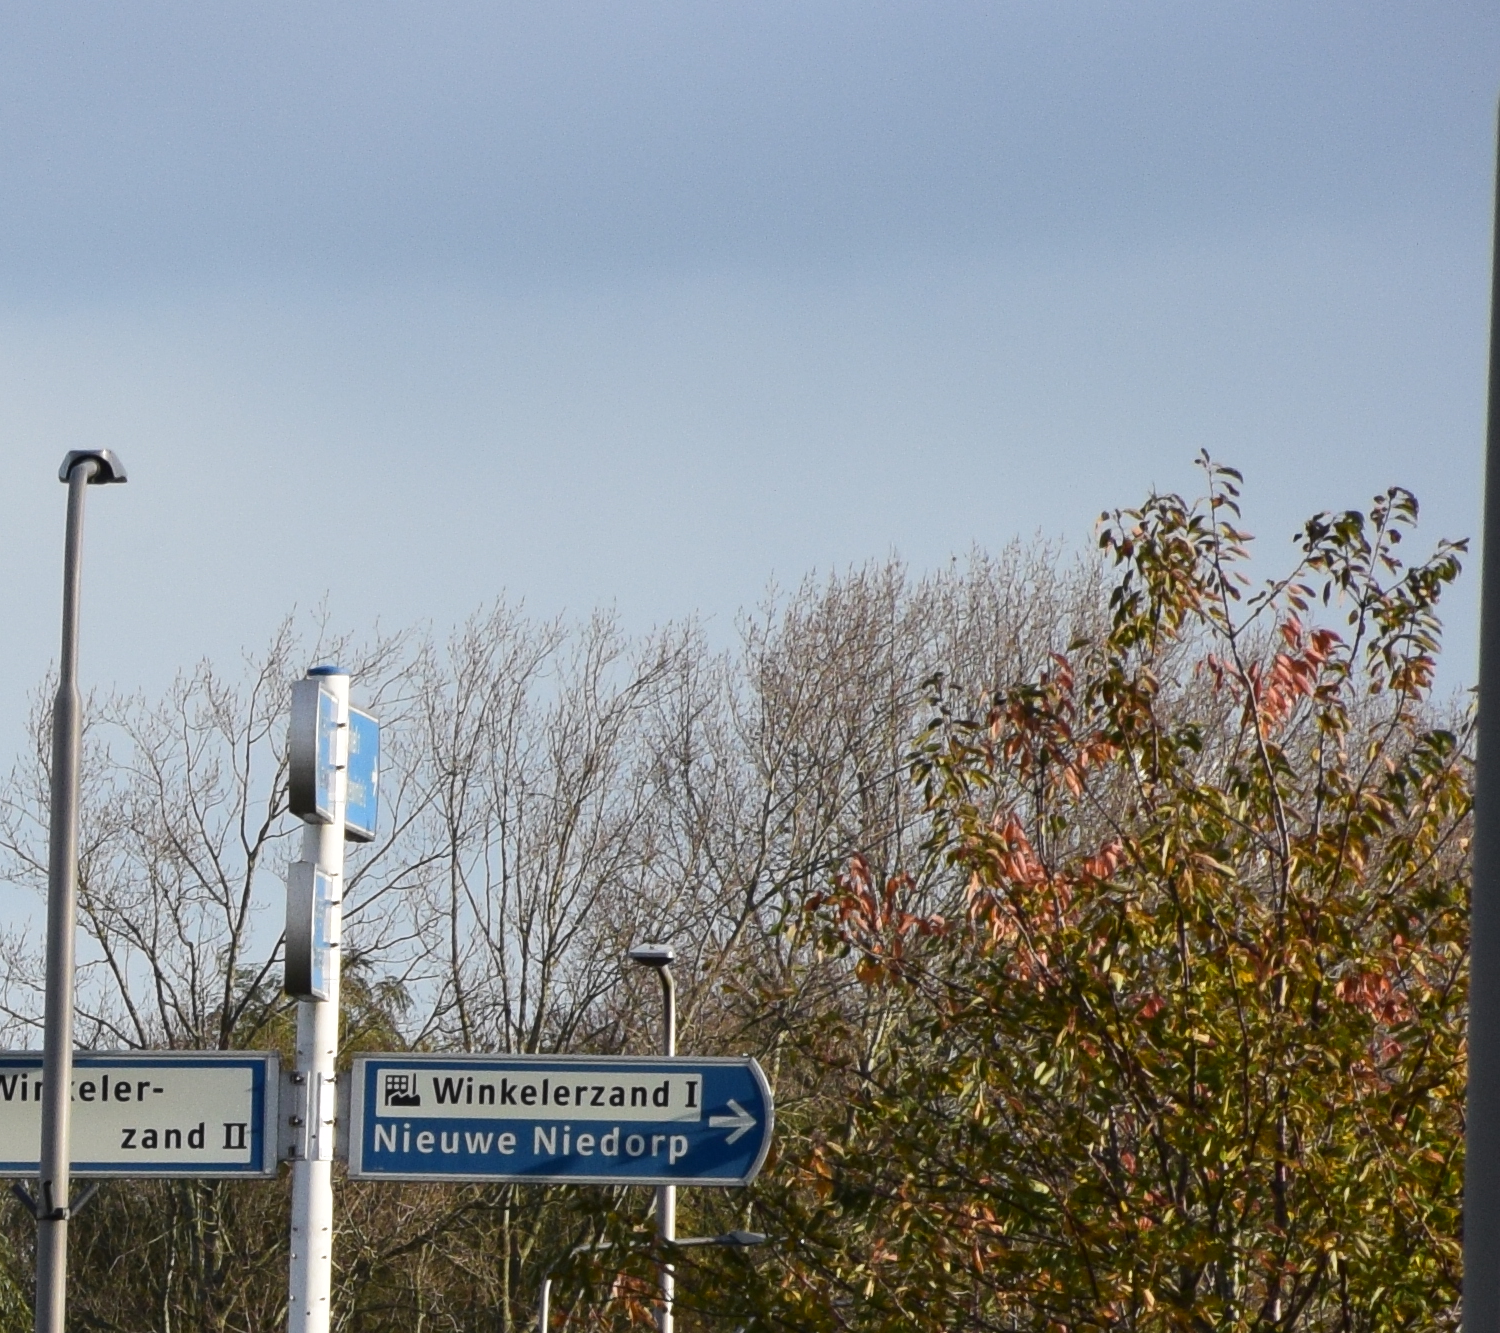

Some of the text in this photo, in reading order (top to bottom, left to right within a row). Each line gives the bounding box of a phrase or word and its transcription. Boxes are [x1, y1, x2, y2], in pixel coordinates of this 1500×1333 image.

[432, 1076, 698, 1108] Winkelerzand I
[121, 1122, 248, 1150] zand II
[373, 1122, 689, 1165] Nieuwe Niedorp
